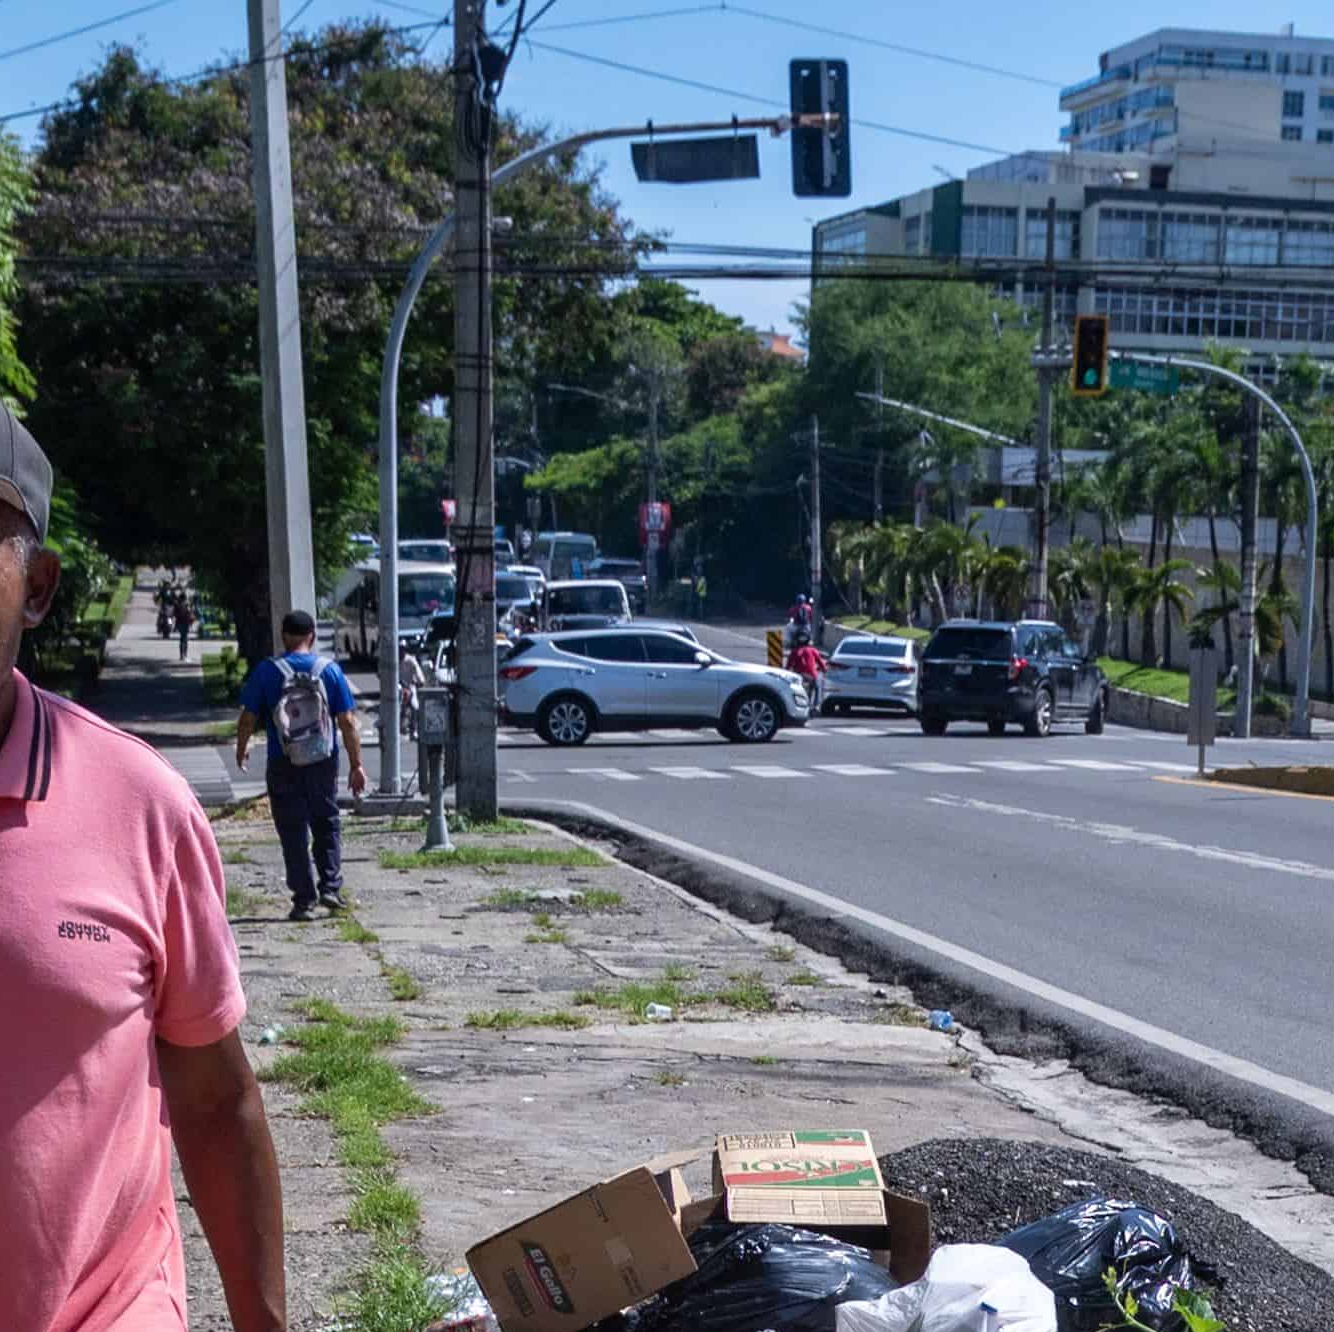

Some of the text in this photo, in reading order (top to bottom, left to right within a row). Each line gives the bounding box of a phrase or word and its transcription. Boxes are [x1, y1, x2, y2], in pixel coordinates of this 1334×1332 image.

[58, 926, 111, 943] COTTON
[730, 1160, 864, 1176] CRISOL
[530, 1248, 564, 1305] El Gallo
